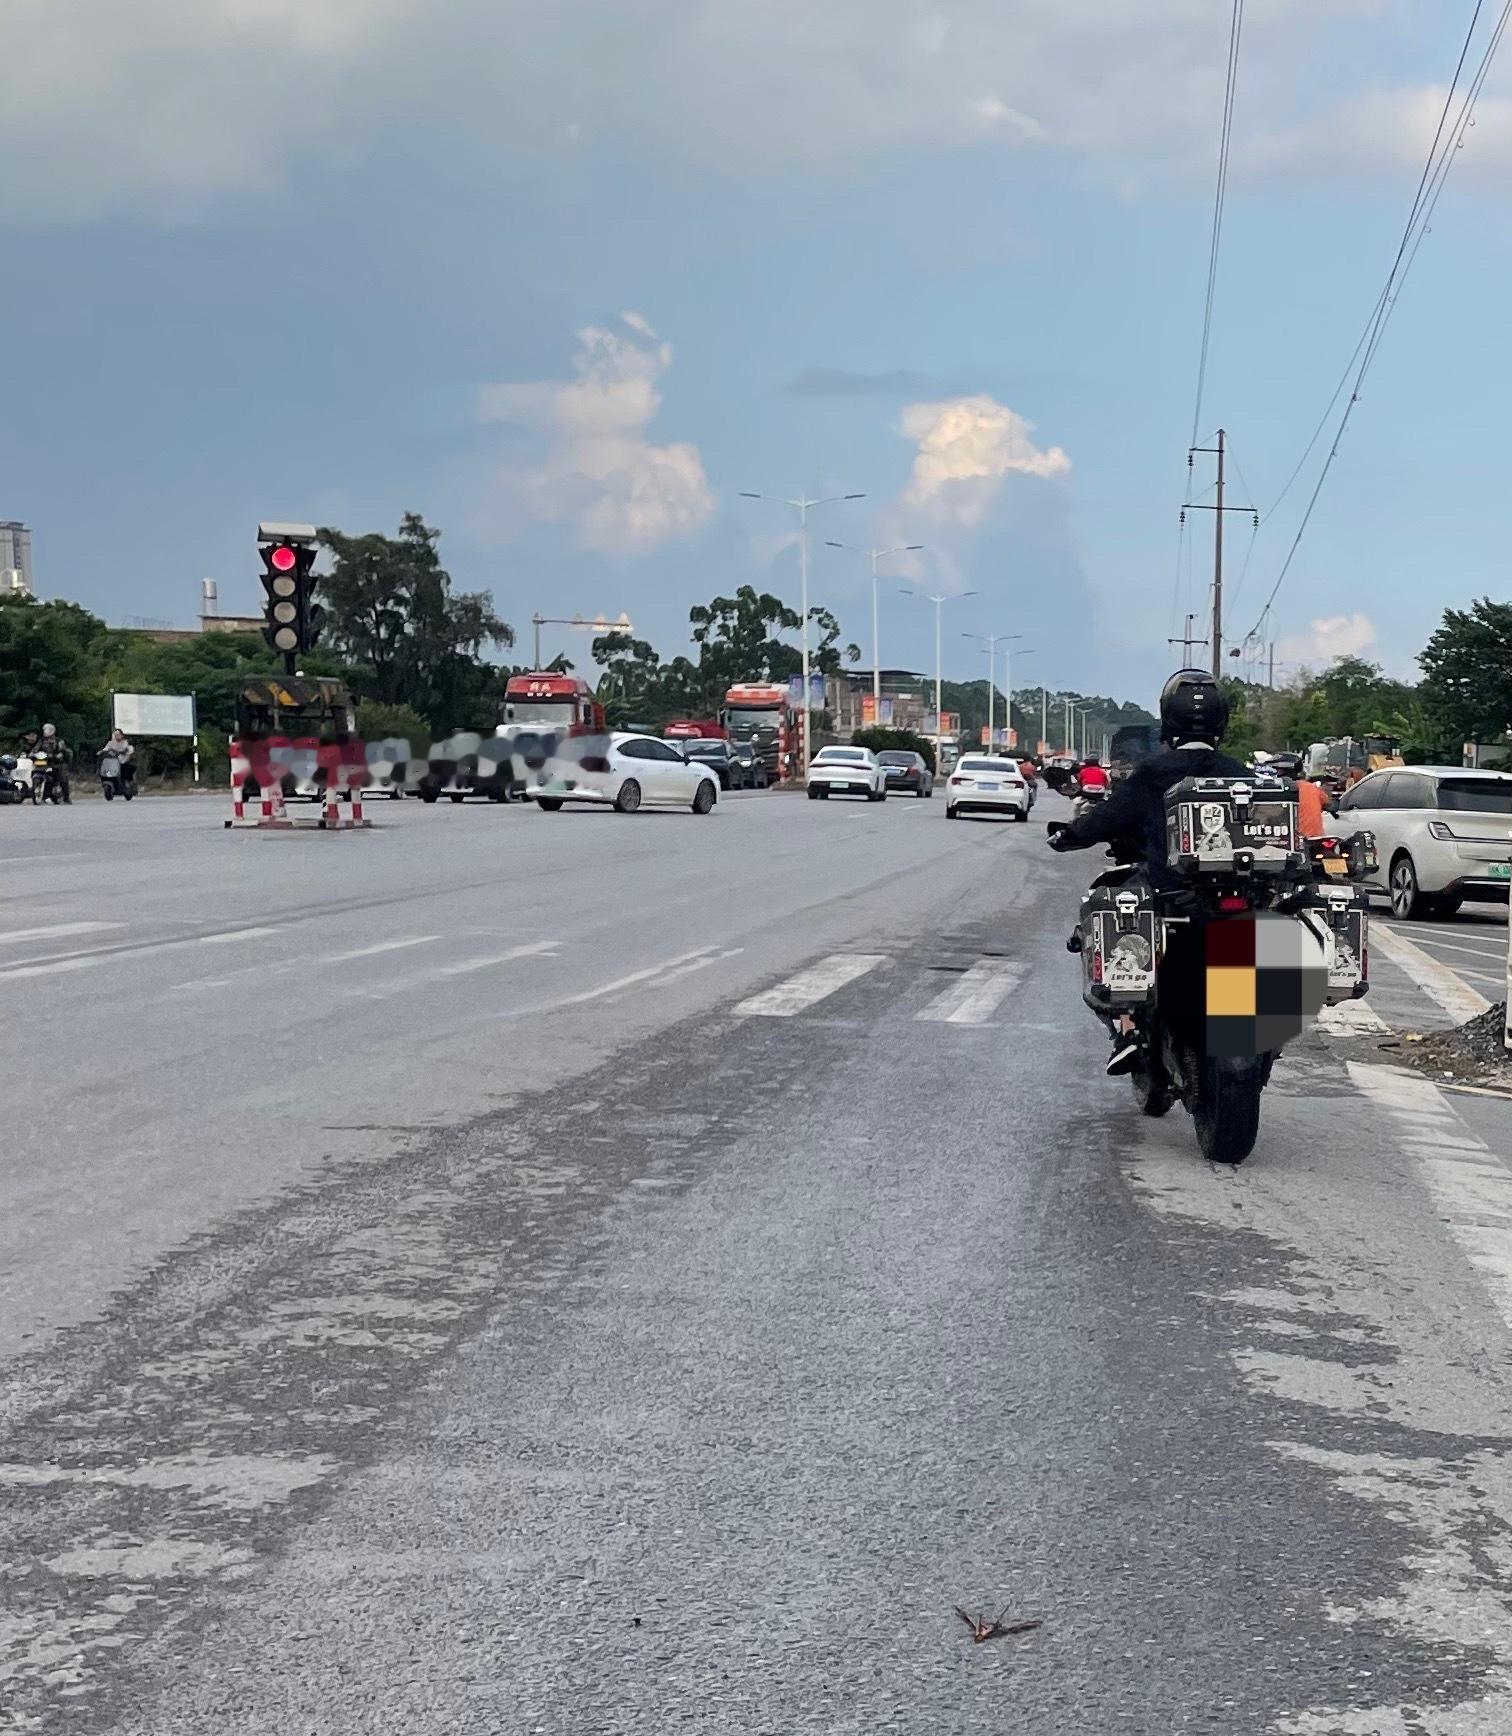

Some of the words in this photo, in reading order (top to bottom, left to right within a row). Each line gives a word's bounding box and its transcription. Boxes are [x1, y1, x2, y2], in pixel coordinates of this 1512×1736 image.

[1243, 824, 1272, 836] Let's
[1273, 825, 1289, 837] go
[1111, 973, 1133, 981] Let's
[1135, 974, 1147, 982] go
